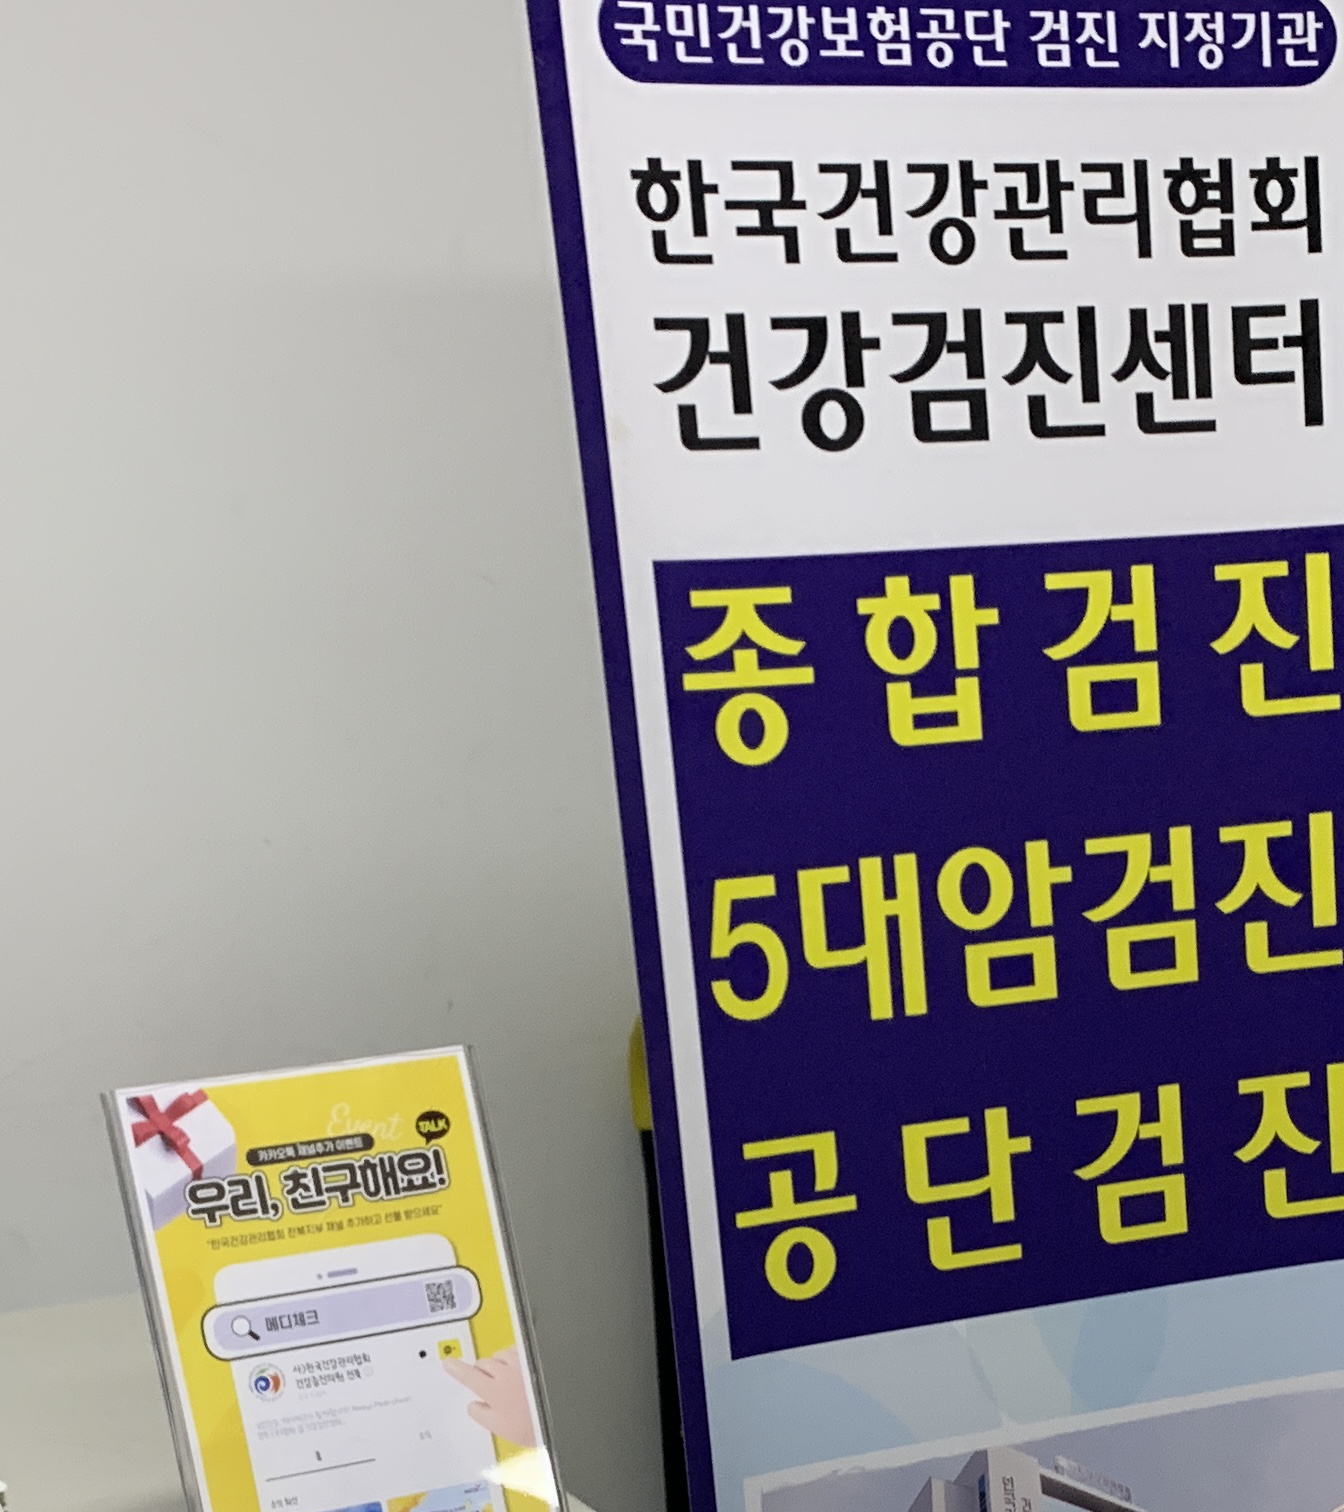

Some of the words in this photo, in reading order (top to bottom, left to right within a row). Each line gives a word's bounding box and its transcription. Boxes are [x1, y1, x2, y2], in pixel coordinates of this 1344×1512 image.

[614, 1, 1011, 68] 국민건강보험공단
[1029, 13, 1119, 68] 검진
[1139, 13, 1323, 68] 지정기관
[630, 155, 1323, 265] 한국건강관리협회
[654, 299, 1324, 451] 건강검진센터
[711, 811, 1344, 1021] 5대암검진
[185, 1172, 280, 1228] 우리,
[281, 1147, 447, 1211] 친구해요!
[263, 1308, 320, 1332] 메디체크
